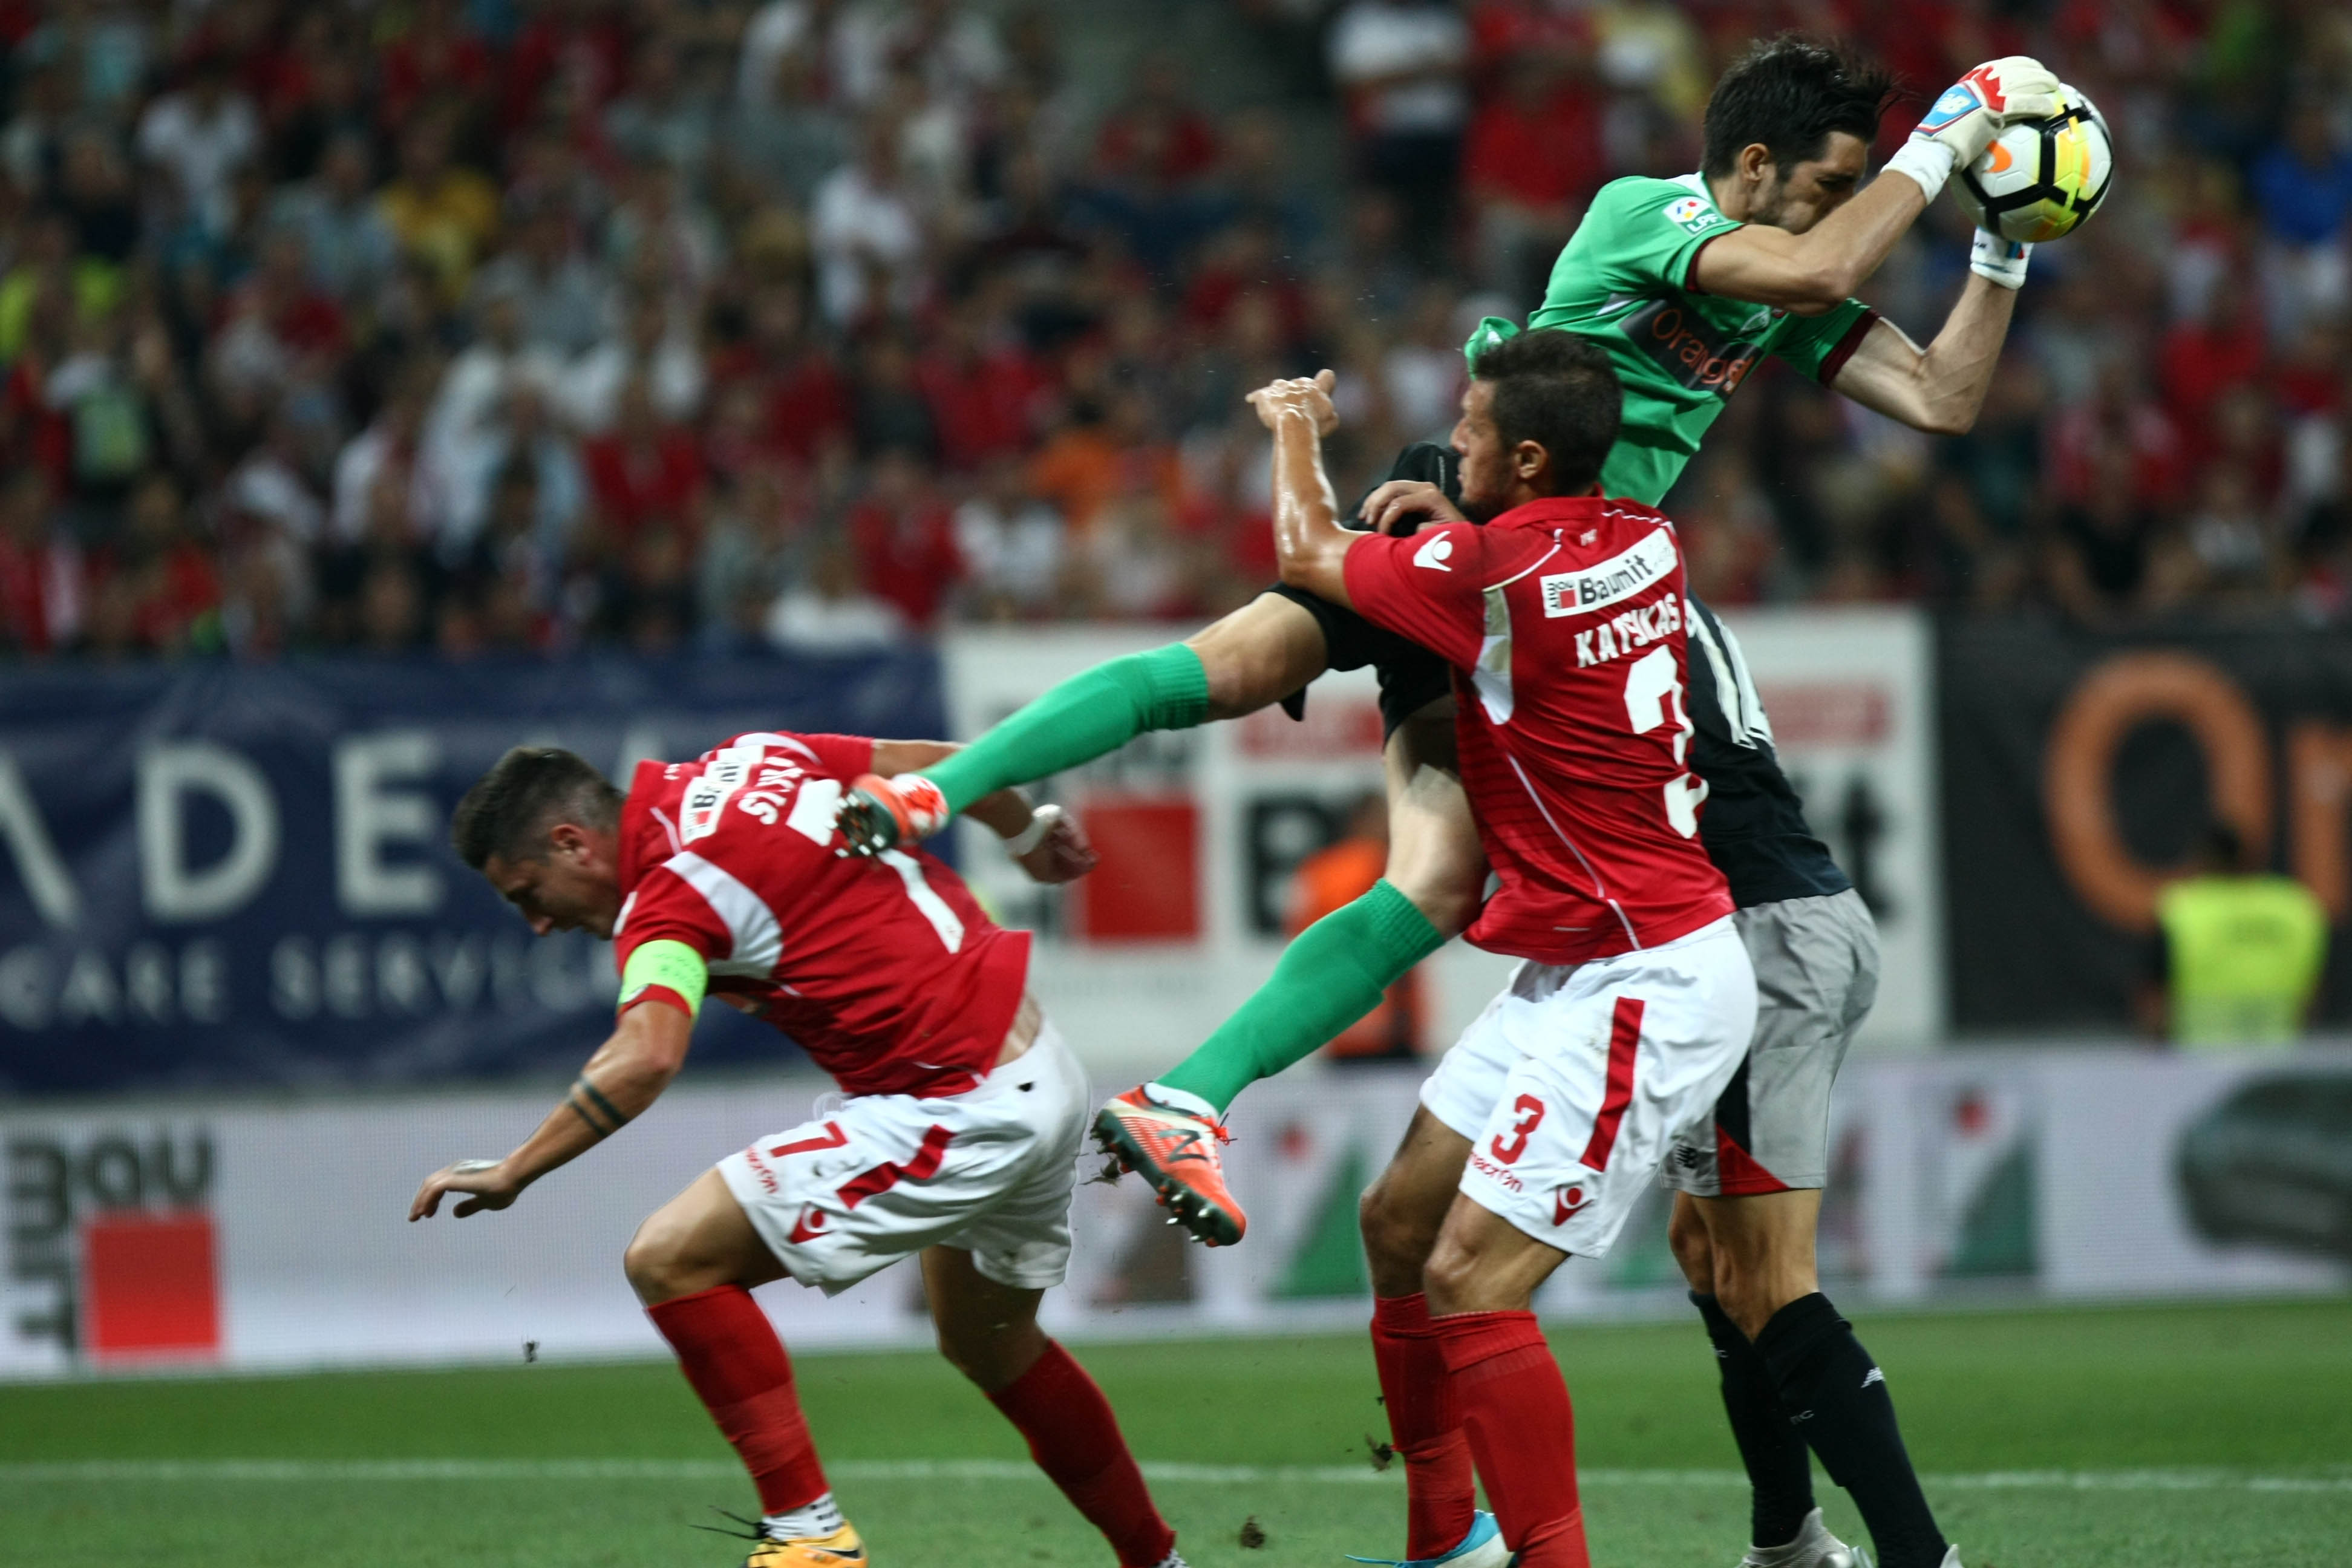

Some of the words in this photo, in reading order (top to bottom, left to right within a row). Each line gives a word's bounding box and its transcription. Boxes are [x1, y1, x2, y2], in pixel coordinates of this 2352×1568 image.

[1686, 213, 1719, 232] LPF
[0, 942, 226, 1028] CARE
[769, 1120, 851, 1158] 7
[1491, 1093, 1545, 1165] 3
